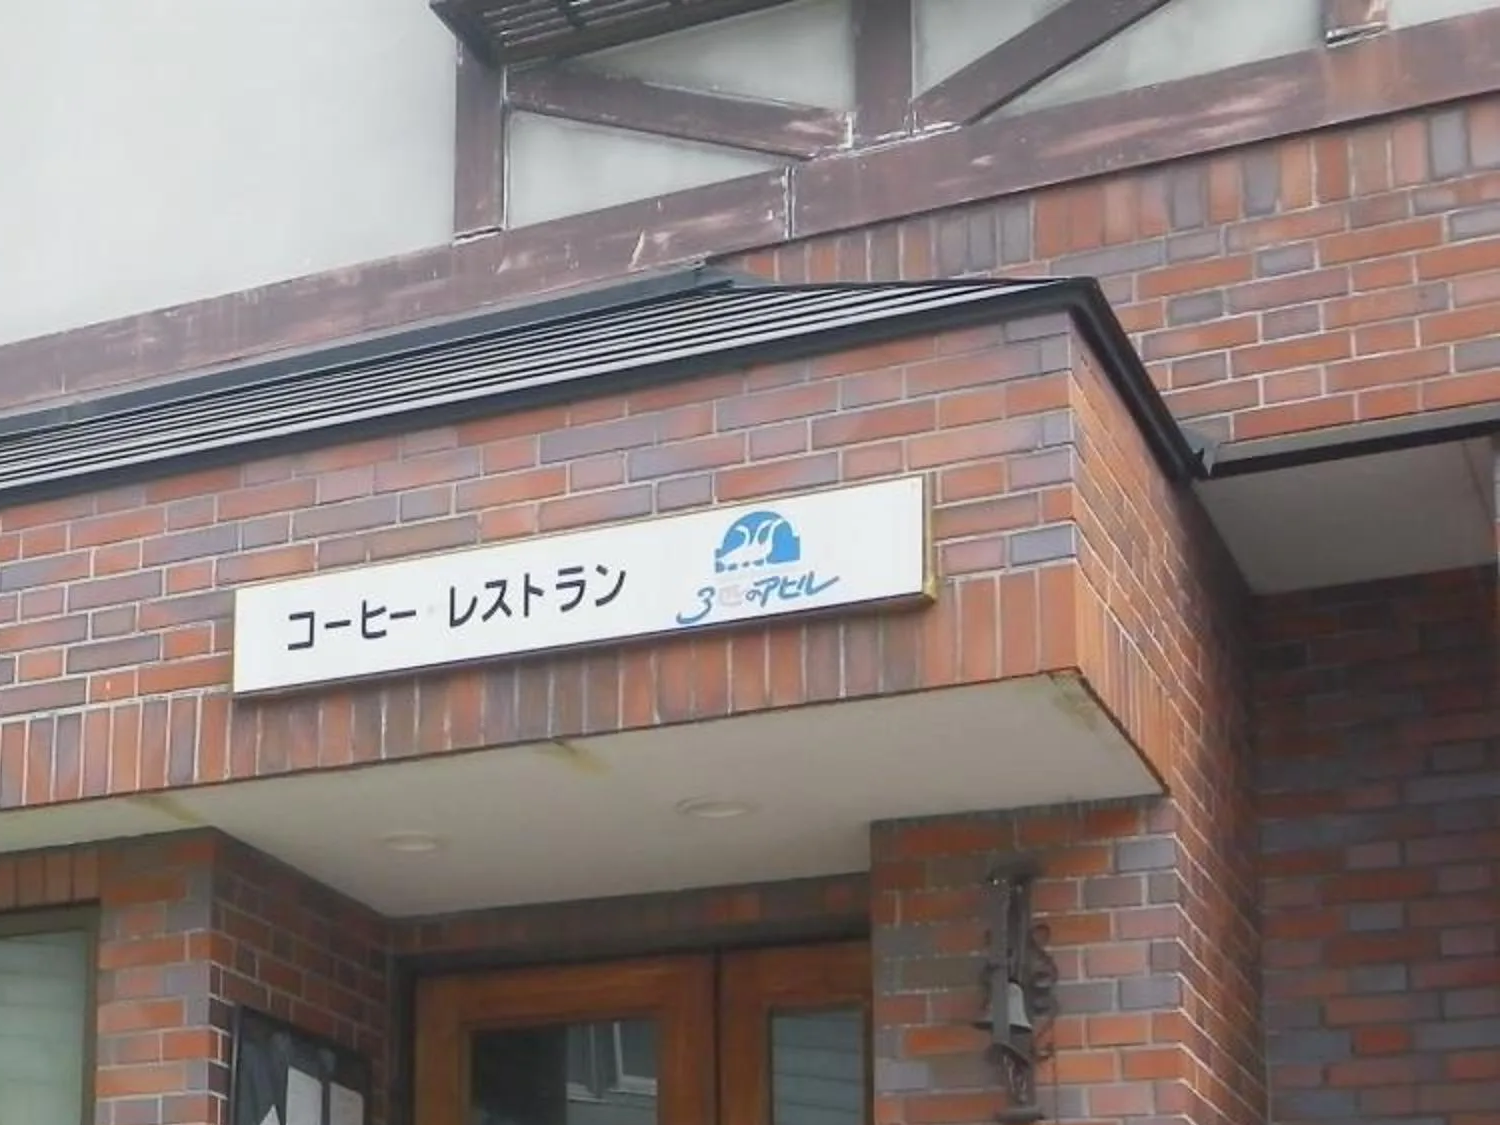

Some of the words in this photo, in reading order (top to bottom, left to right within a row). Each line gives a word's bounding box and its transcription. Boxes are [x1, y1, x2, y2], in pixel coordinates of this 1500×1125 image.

[287, 600, 418, 651] コーヒー
[448, 564, 628, 629] レストラン
